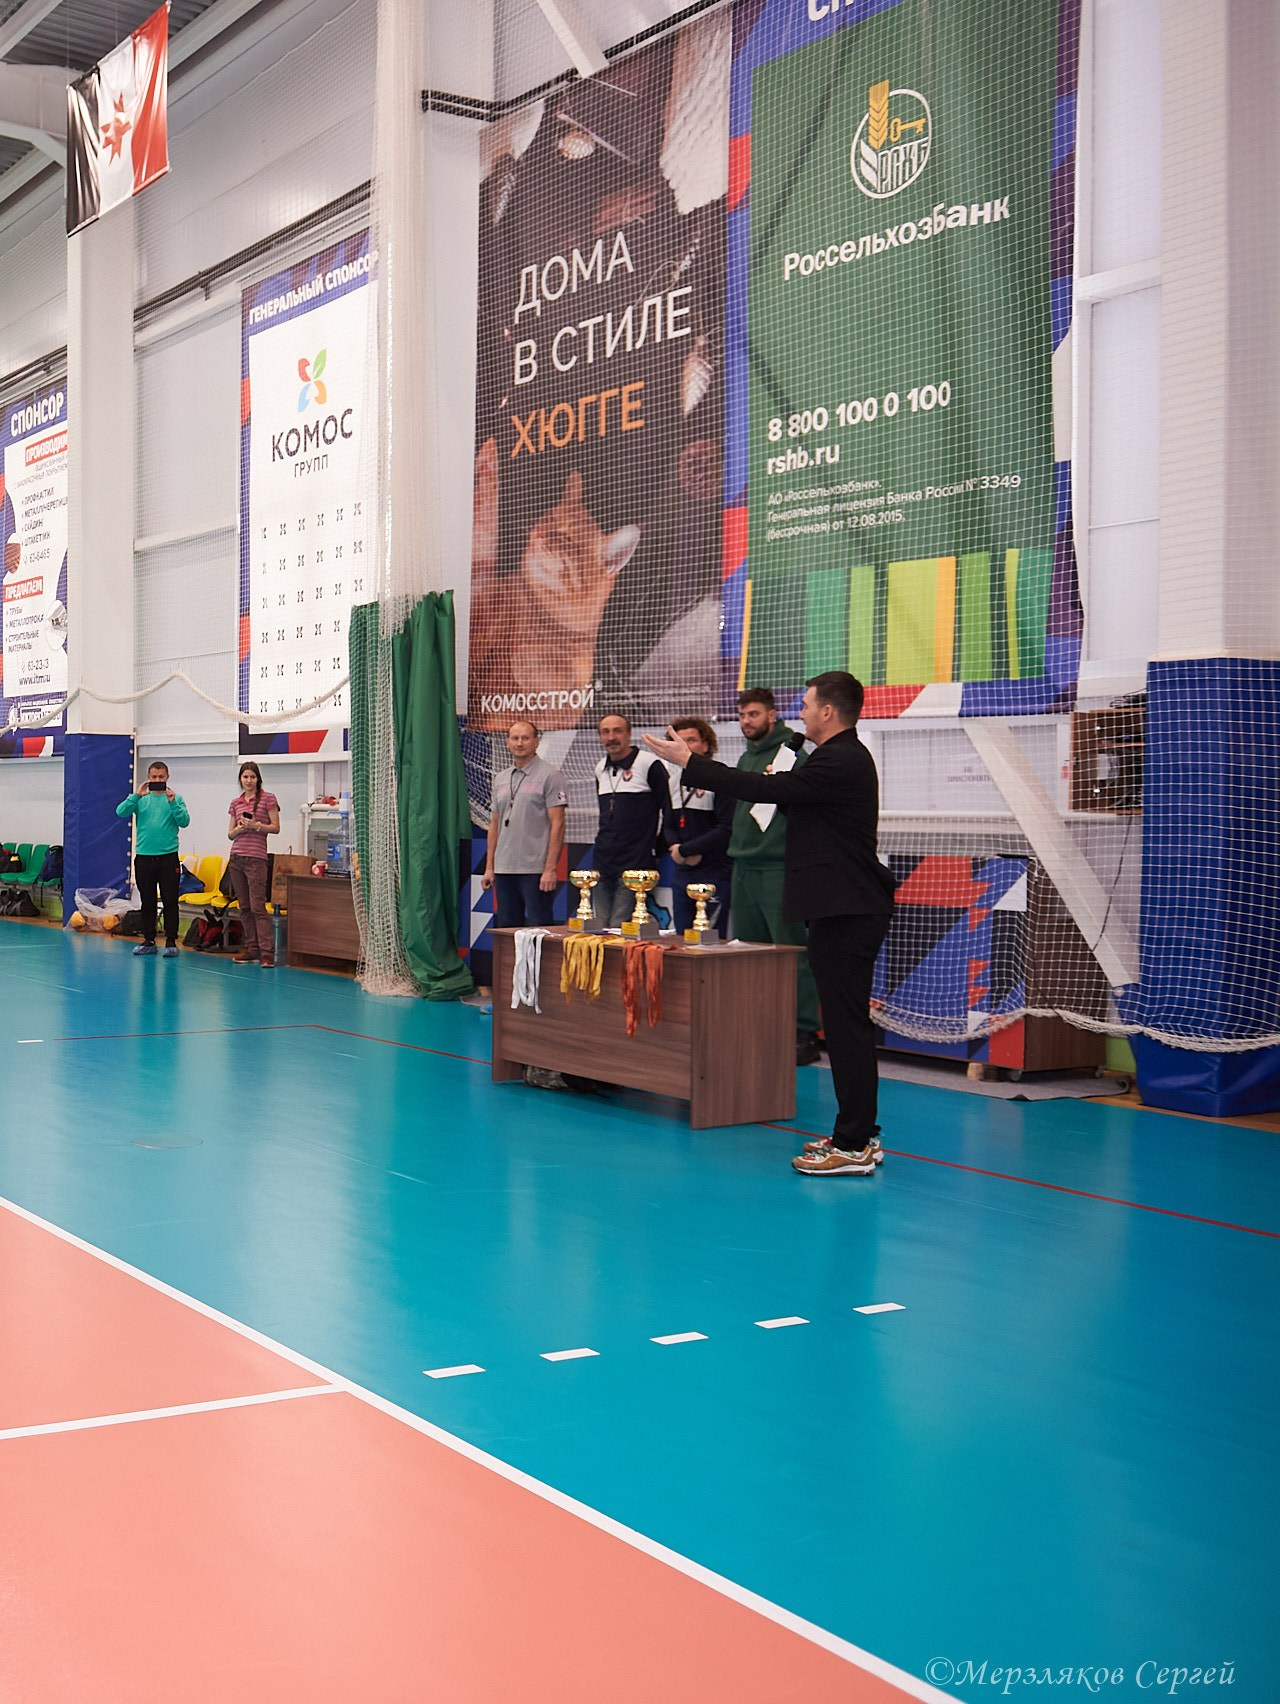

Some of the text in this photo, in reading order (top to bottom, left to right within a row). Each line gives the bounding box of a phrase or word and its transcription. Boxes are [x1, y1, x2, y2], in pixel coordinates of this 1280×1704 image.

[784, 196, 1011, 281] Россельхозбанк
[249, 274, 324, 326] ГЕНЕРАЛЬНЫЙ
[514, 232, 634, 324] ДОМА
[514, 286, 693, 385] В СТИЛЕ
[11, 392, 64, 437] СПОНСОР
[272, 408, 353, 463] КОМОС
[510, 381, 646, 458] ХЮГГЕ
[768, 380, 952, 442] 8 800 100 0 100
[294, 454, 329, 478] ГРУПП
[767, 444, 840, 475] rshb.ru
[768, 504, 830, 522] Генеральная
[832, 496, 885, 513] лицензия
[886, 490, 922, 504] Банка
[925, 483, 964, 499] России
[980, 475, 1021, 489] 3349
[768, 493, 783, 506] АО
[766, 520, 830, 542] (бессрочная)
[832, 520, 844, 531] от
